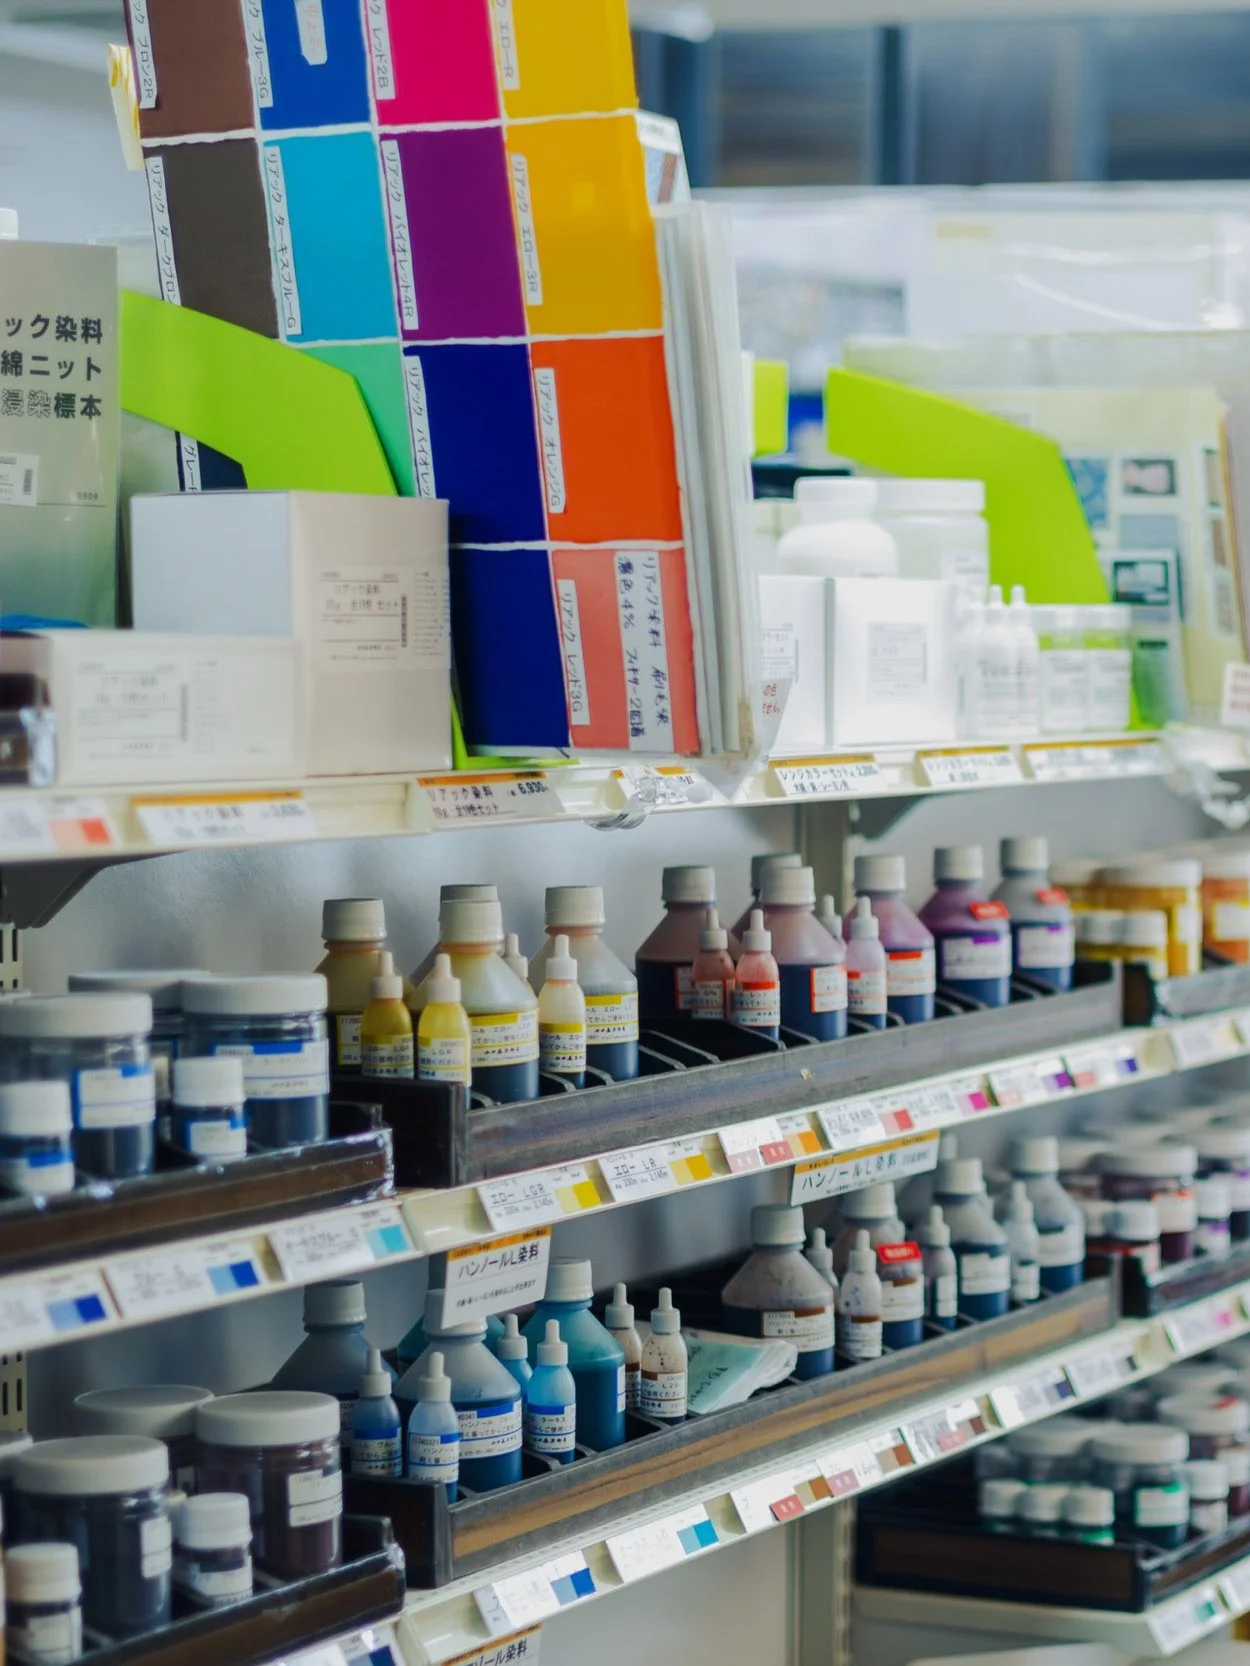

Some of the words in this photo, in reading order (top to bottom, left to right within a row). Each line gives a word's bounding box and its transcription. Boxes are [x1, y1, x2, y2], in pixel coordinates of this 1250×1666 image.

[137, 34, 154, 99] ブロン2R
[252, 31, 271, 100] ブルー3G
[373, 28, 389, 89] レッド2B
[149, 162, 165, 217] リアック
[514, 161, 529, 215] リアック
[266, 152, 283, 205] リアック
[276, 211, 298, 330] ターキスブルーG
[387, 152, 402, 202] リアック
[395, 211, 413, 319] バイオレット4R
[1, 350, 102, 381] 綿ニット
[410, 365, 424, 417] リアック
[538, 374, 555, 427] リアック
[544, 435, 563, 510] オレンジG
[558, 591, 577, 644] リアック
